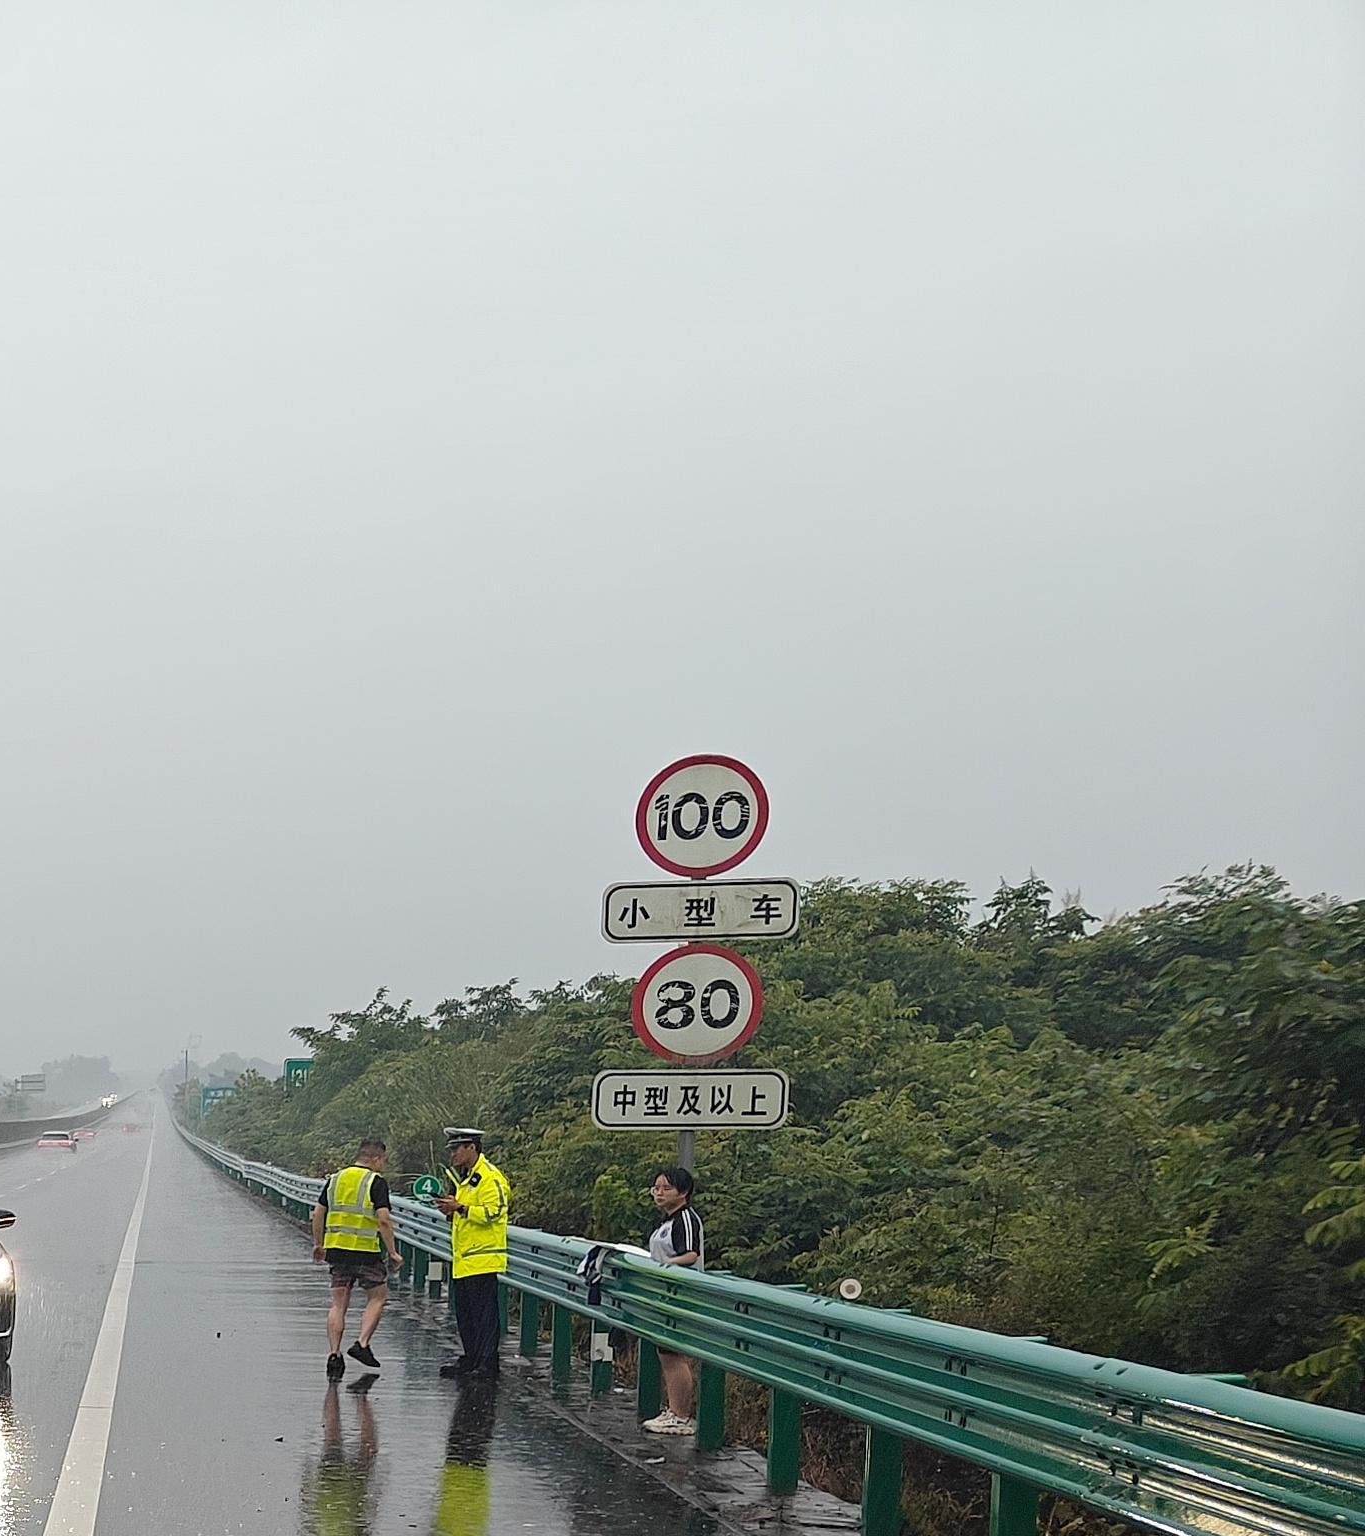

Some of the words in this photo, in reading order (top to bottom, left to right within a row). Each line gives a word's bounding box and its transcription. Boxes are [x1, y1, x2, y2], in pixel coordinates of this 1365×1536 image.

[655, 791, 751, 841] 100
[618, 894, 783, 929] 小型车
[655, 979, 740, 1030] 80
[612, 1084, 767, 1117] 中型及以上
[422, 1179, 433, 1193] 4
